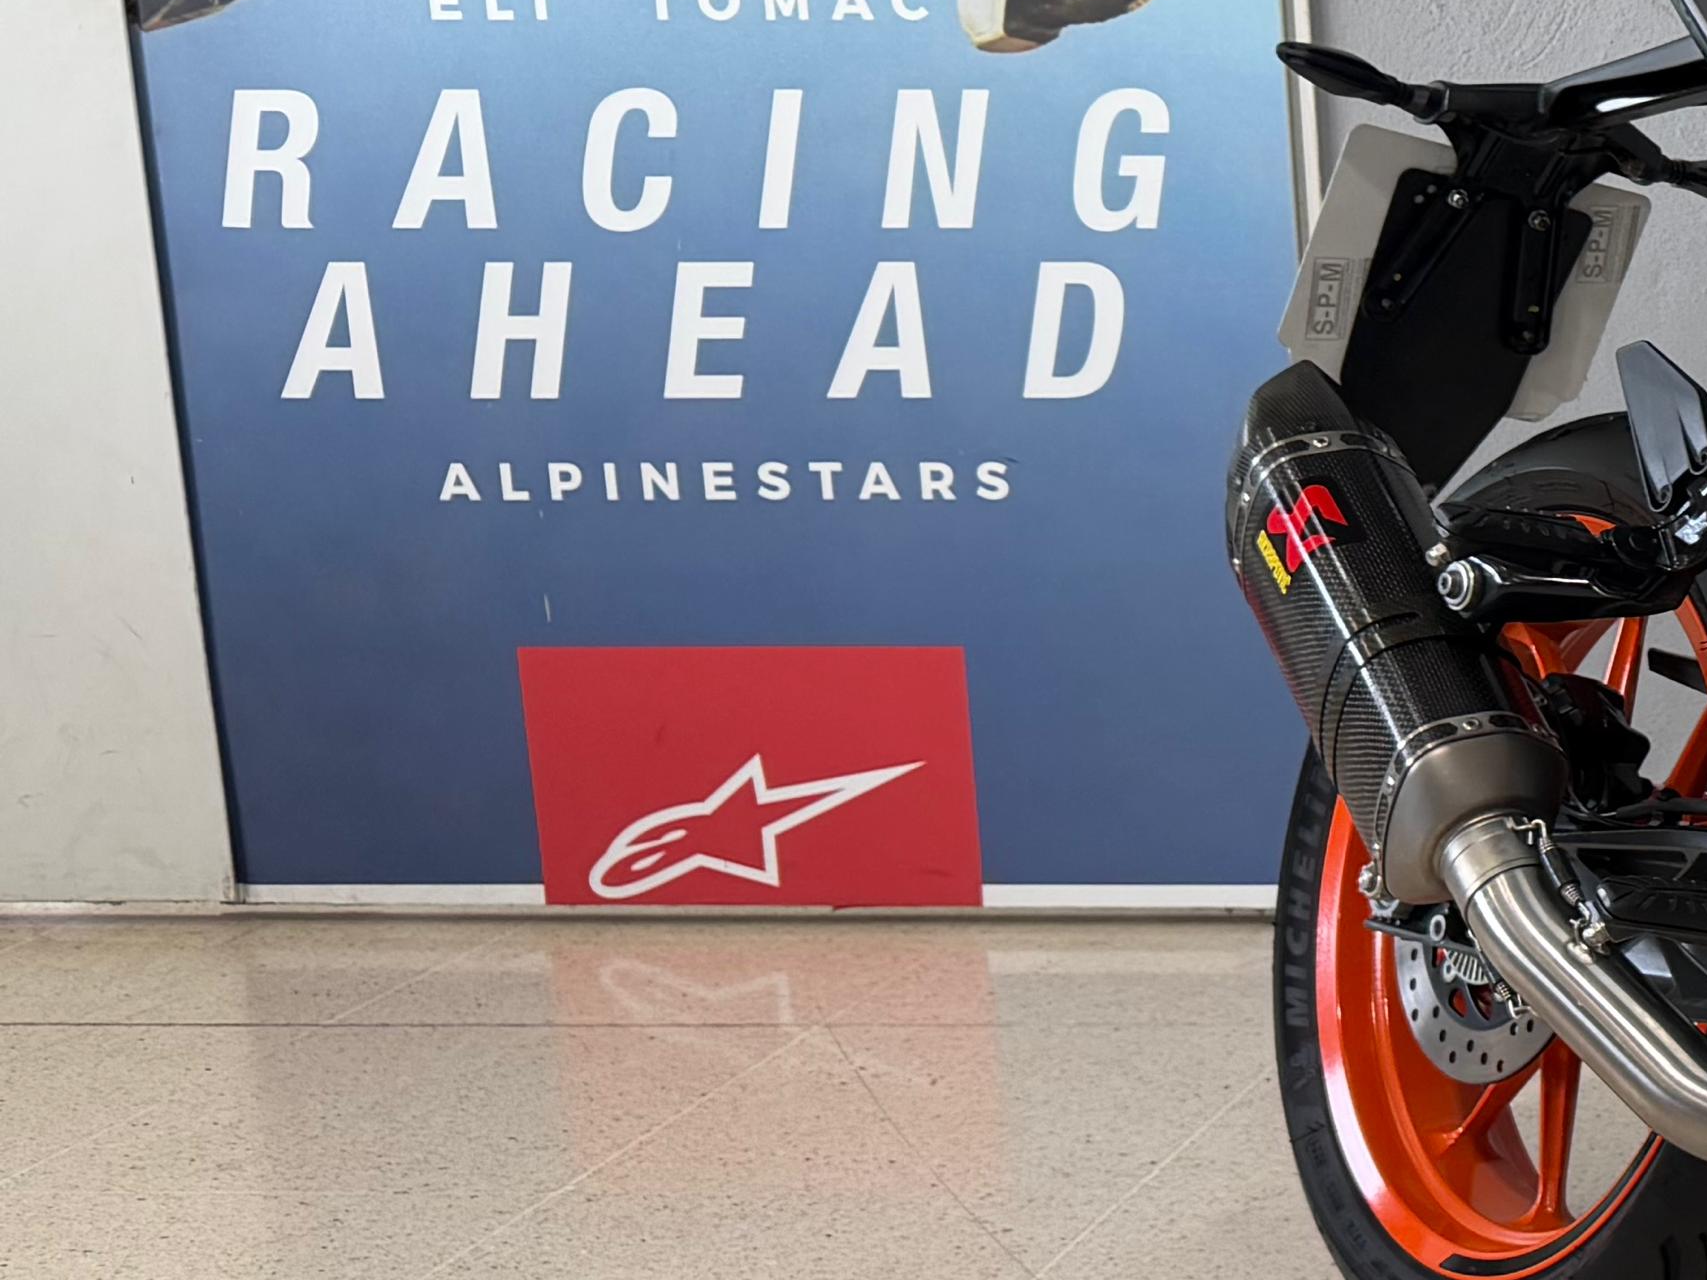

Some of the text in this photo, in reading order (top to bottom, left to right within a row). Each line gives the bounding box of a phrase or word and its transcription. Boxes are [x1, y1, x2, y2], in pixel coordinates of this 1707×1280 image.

[221, 87, 1171, 231] RACING
[281, 260, 1126, 400] AHEAD
[439, 460, 1012, 502] ALPINESTARS
